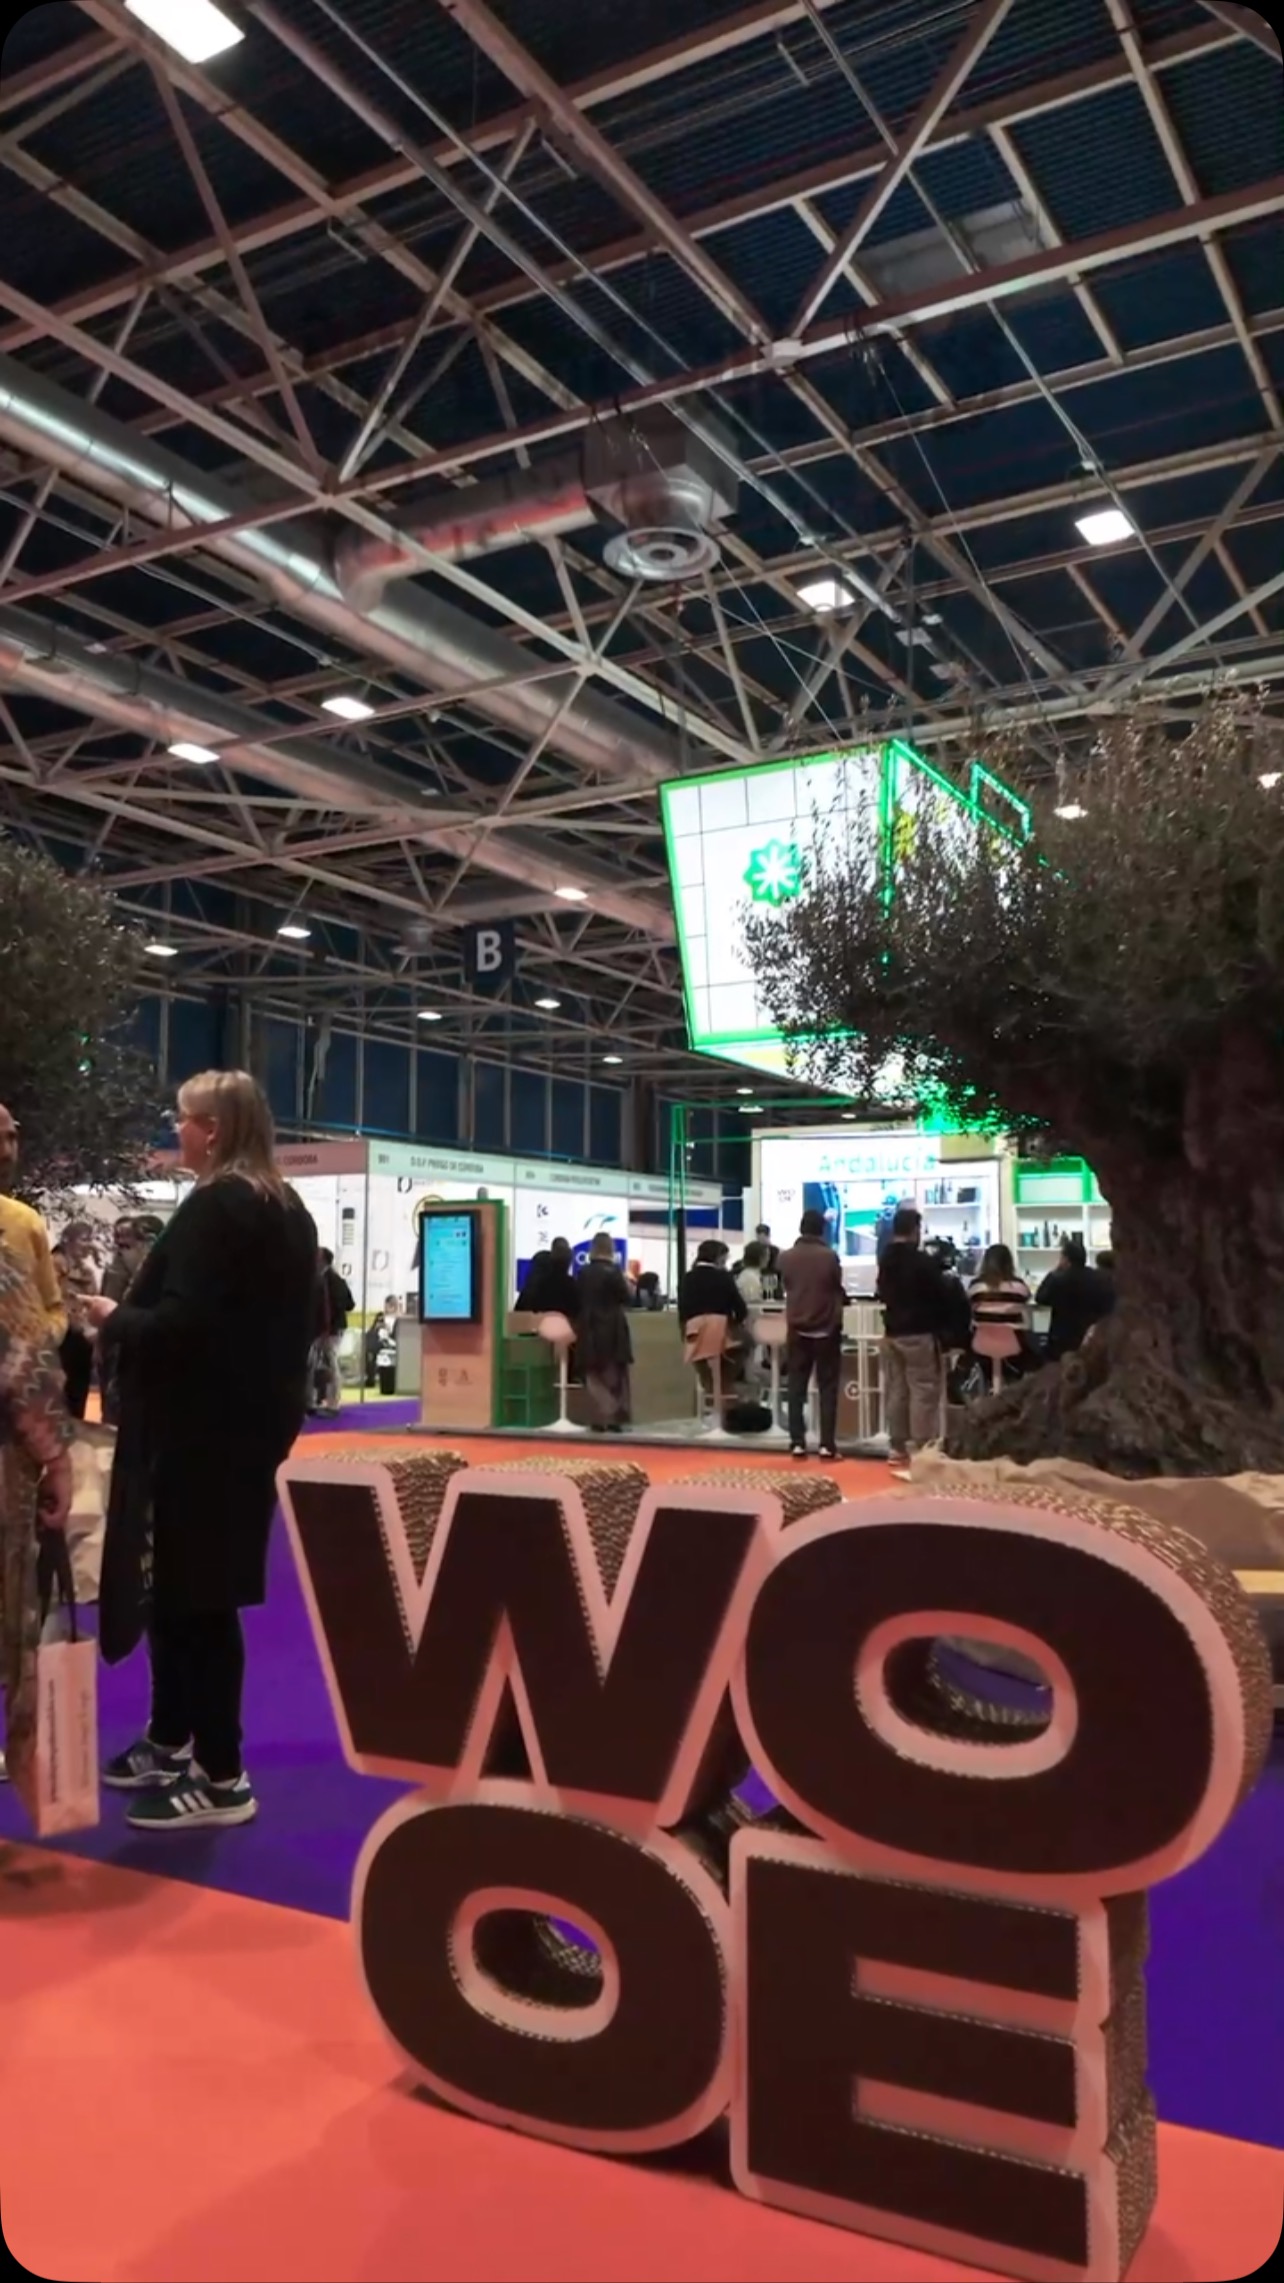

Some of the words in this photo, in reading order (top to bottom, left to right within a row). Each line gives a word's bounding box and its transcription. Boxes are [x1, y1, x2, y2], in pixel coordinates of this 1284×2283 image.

[476, 929, 502, 973] B
[277, 1461, 1246, 1896] WO
[350, 1782, 1112, 2282] OE
